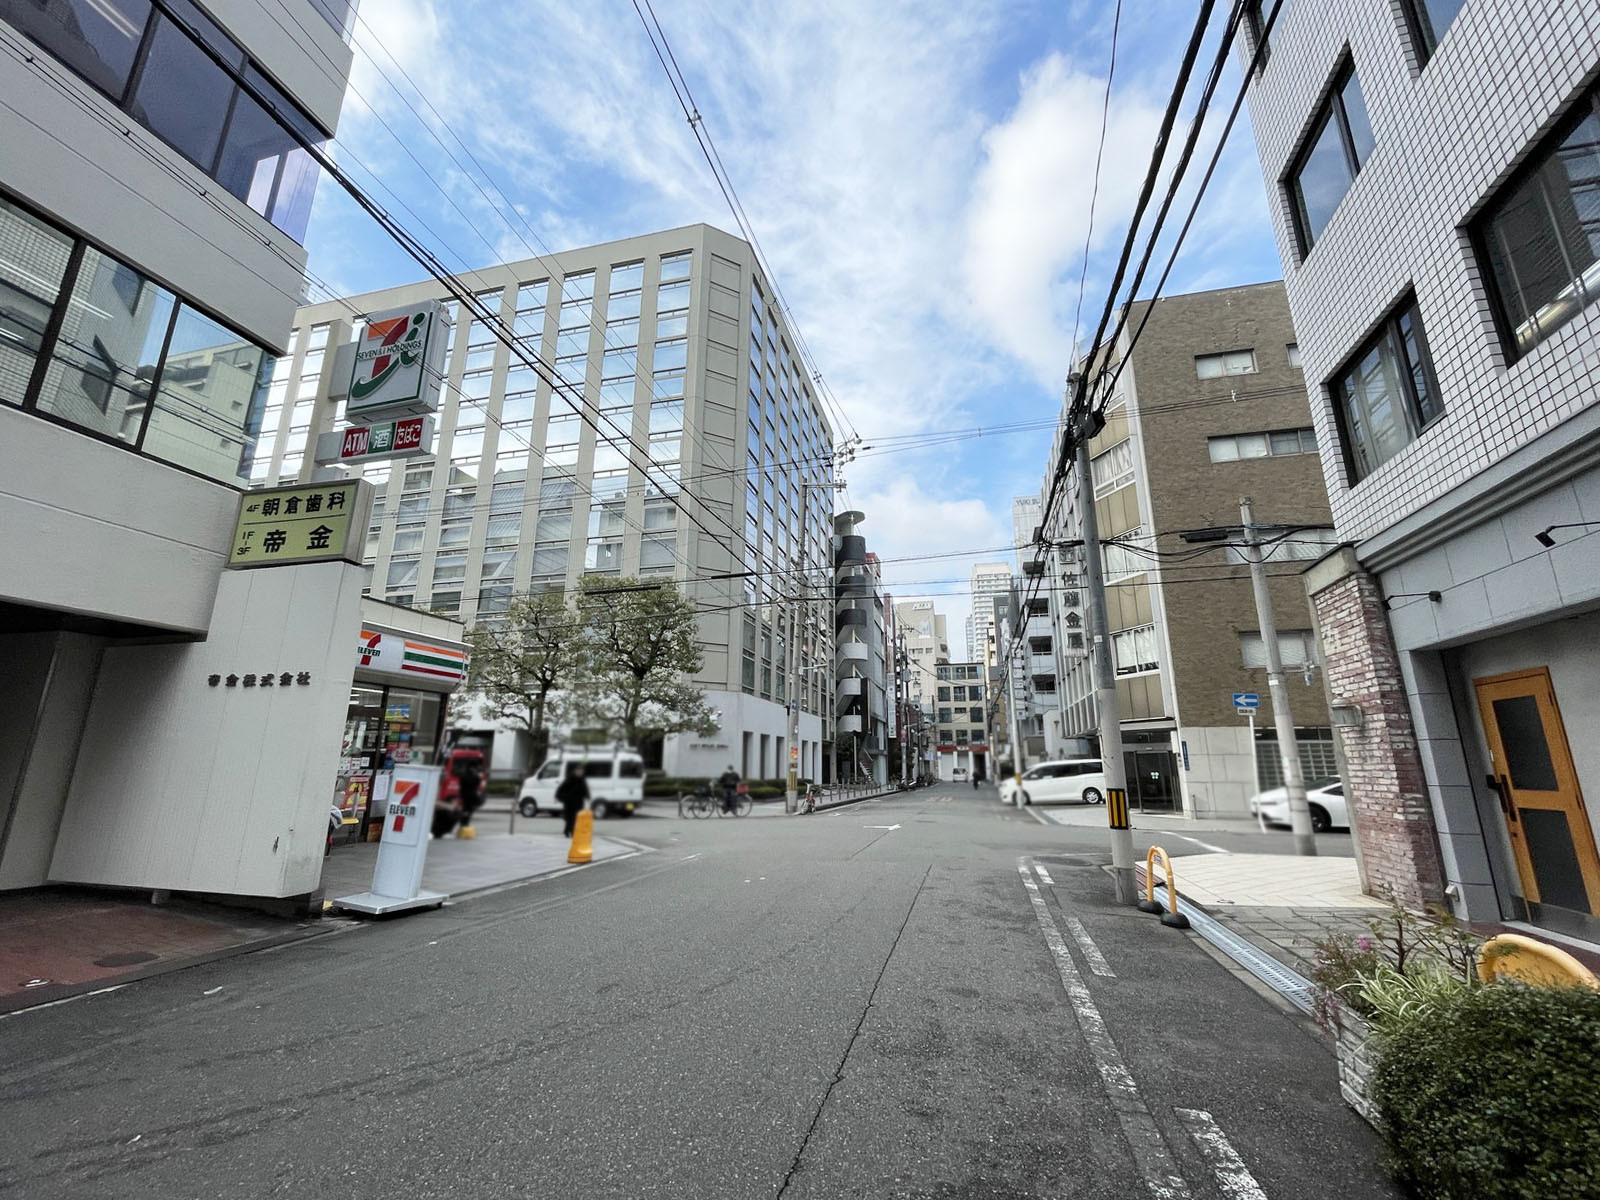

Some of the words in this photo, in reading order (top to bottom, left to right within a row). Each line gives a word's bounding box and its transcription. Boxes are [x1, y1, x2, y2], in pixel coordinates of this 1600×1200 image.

[343, 432, 368, 453] ATM
[372, 428, 392, 449] 酒
[395, 423, 421, 445] たばこ
[246, 503, 260, 513] 4F
[261, 490, 346, 517] 朝倉歯科
[242, 530, 256, 540] 1F
[263, 524, 334, 553] 帝金
[236, 546, 252, 556] 3F
